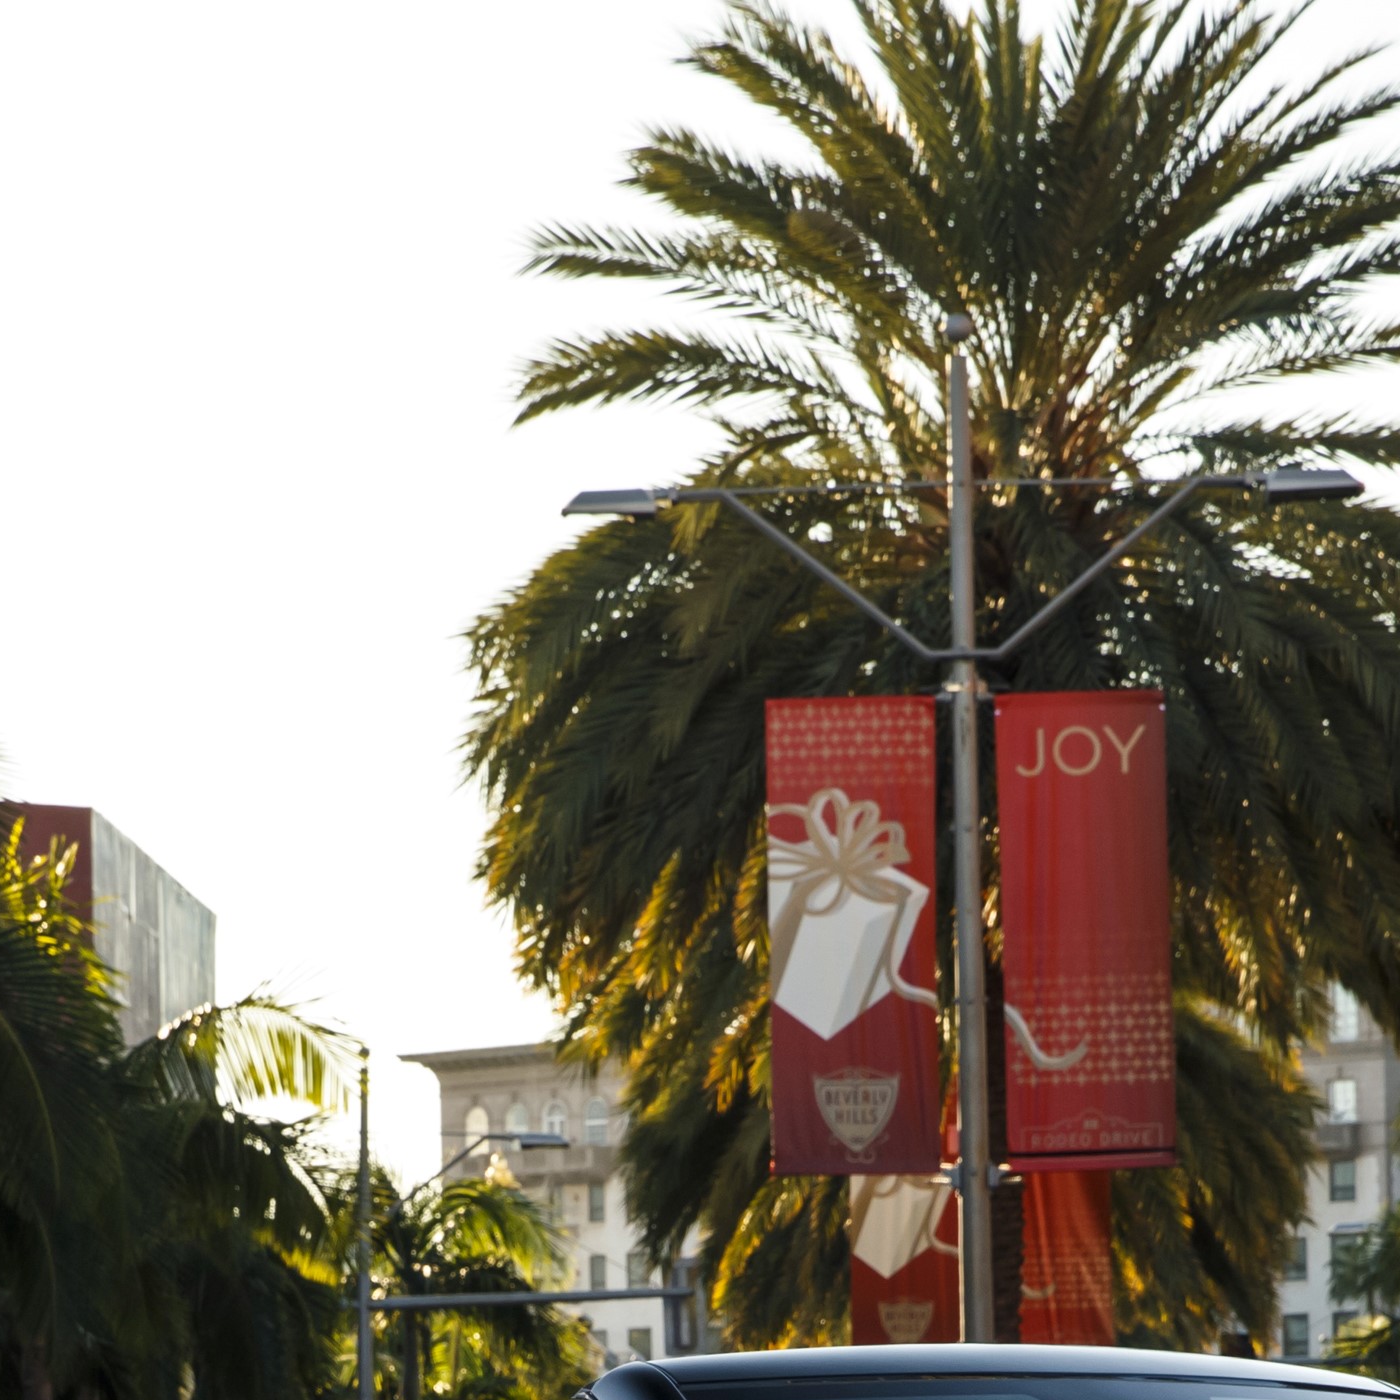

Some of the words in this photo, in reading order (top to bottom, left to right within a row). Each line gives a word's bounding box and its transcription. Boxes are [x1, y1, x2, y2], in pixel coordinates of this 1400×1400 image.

[1016, 724, 1145, 777] JOY
[825, 1089, 888, 1105] BEVERLY
[835, 1108, 878, 1124] HILLS
[1031, 1131, 1091, 1149] RODEO
